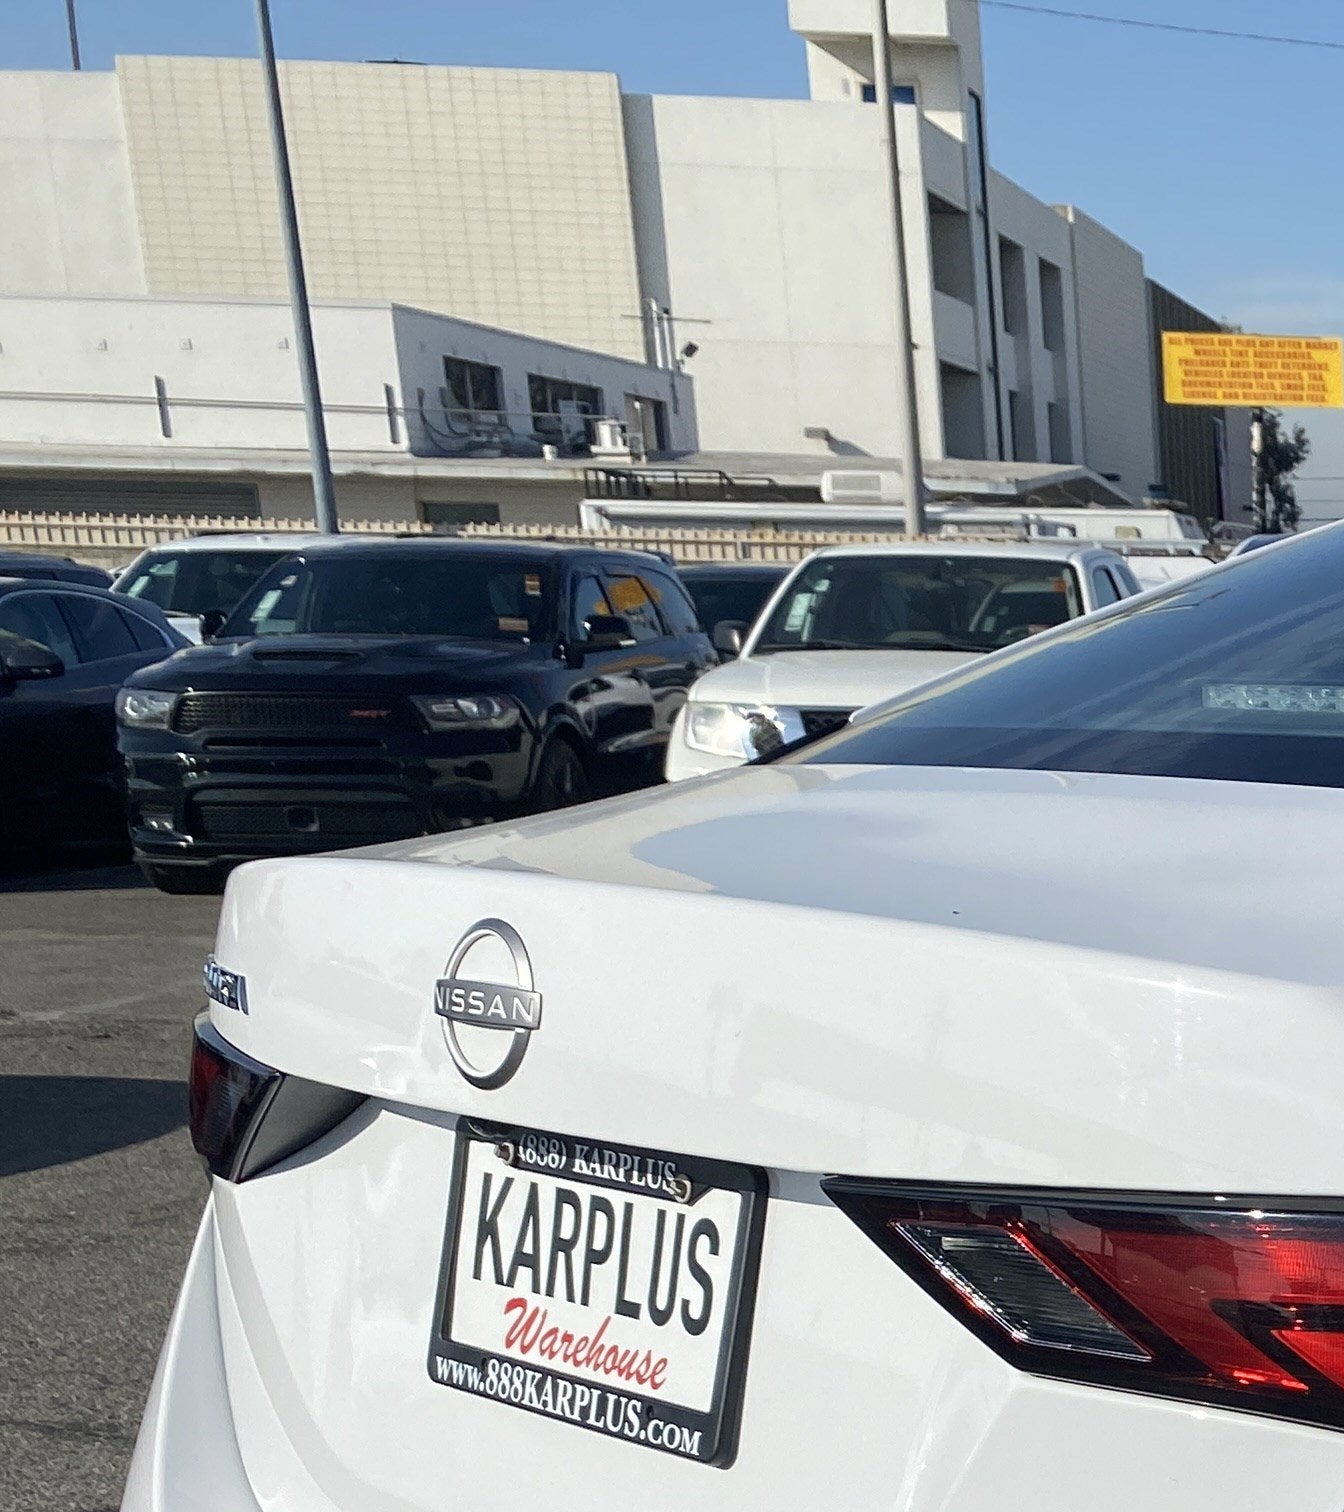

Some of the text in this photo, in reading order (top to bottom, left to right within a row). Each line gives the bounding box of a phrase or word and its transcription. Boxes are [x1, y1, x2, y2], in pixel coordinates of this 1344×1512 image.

[434, 985, 535, 1023] NISSAN
[518, 1133, 678, 1194] (888) KARPLUS
[472, 1172, 720, 1336] KARPLUS
[503, 1297, 669, 1390] Warehouse
